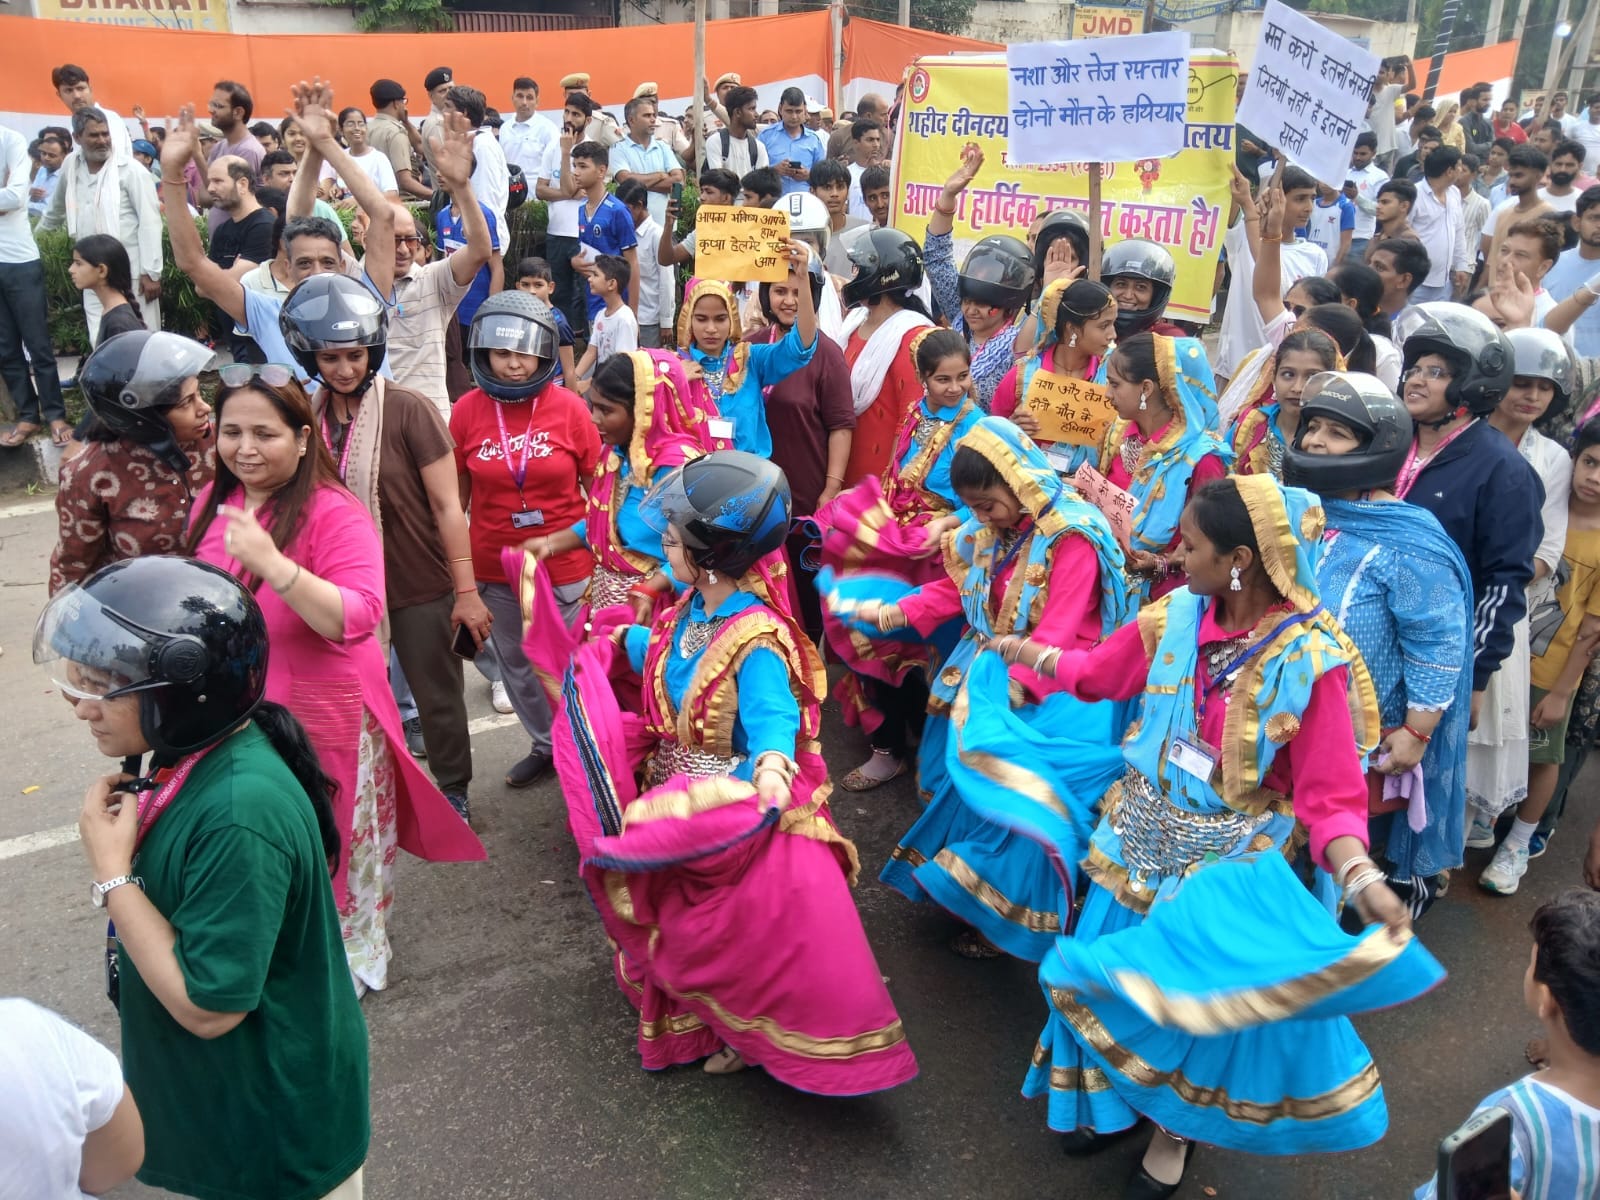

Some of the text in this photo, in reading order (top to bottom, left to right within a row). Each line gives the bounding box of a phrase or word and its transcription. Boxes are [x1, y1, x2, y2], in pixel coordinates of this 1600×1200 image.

[1083, 16, 1132, 35] JMD
[1010, 66, 1047, 86] नशा
[1051, 58, 1081, 85] और
[1085, 52, 1119, 82] तेज
[1265, 22, 1377, 102] मत करो इतनी मस्ती
[908, 107, 948, 137] शहीद
[952, 108, 1008, 138] दीनदय
[1012, 99, 1056, 129] दोनों
[1059, 98, 1095, 126] मौत
[1096, 95, 1116, 124] के
[1311, 99, 1323, 125] है
[1321, 110, 1357, 146] इतनी
[1279, 121, 1309, 156] सस्ती
[697, 211, 727, 223] आपका
[971, 182, 1039, 229] हार्दिक
[1119, 203, 1187, 245] करता
[1080, 407, 1093, 422] के
